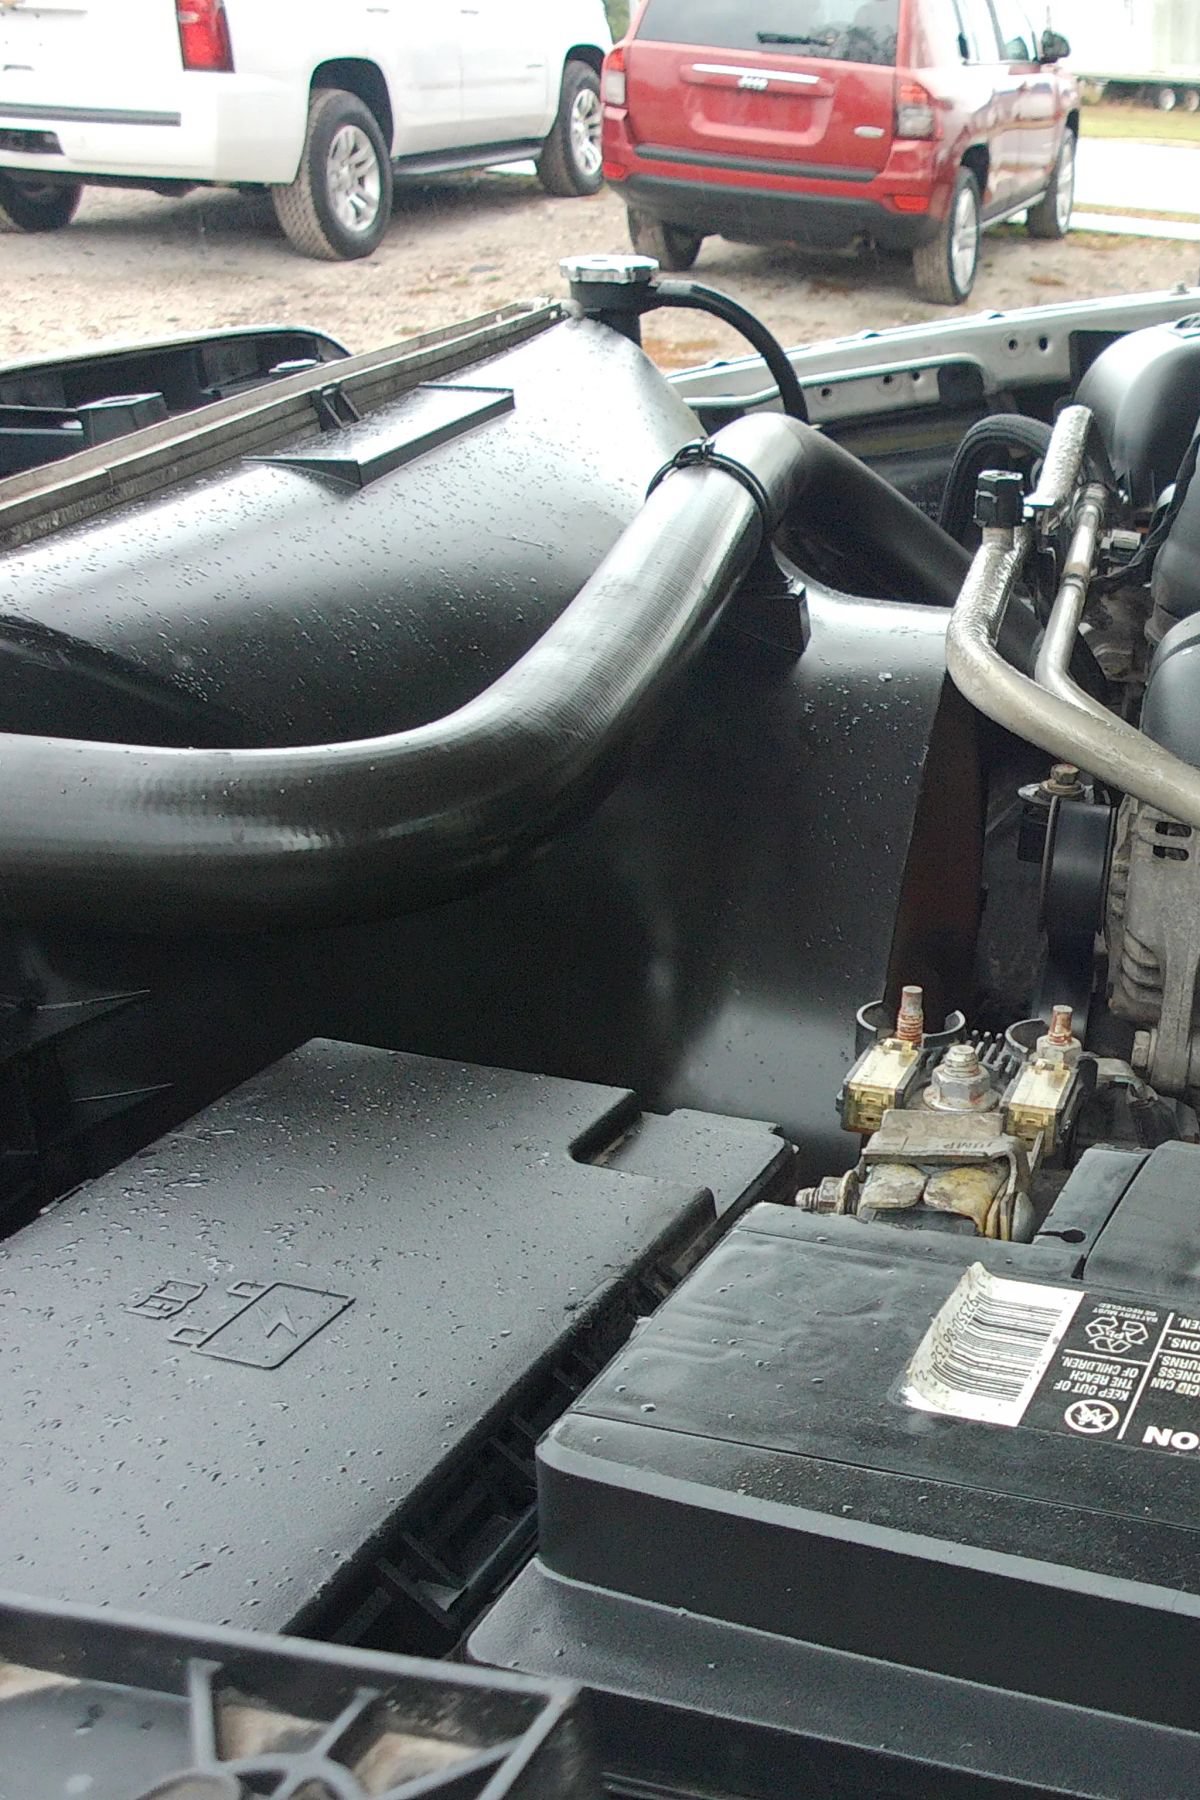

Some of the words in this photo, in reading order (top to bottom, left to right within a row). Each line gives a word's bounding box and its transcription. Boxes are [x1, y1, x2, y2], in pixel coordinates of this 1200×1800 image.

[1092, 1307, 1118, 1317] MUST
[1098, 1303, 1144, 1315] RECYCLED
[1118, 1311, 1159, 1323] BATTERY
[1061, 1354, 1119, 1374] CHILDREN.
[1119, 1364, 1139, 1378] OF
[1069, 1368, 1109, 1385] REACH
[1108, 1375, 1133, 1390] THE
[1150, 1376, 1177, 1391] CAN
[1053, 1378, 1071, 1392] OF
[1071, 1381, 1098, 1396] OUT
[1098, 1386, 1130, 1402] KEEP
